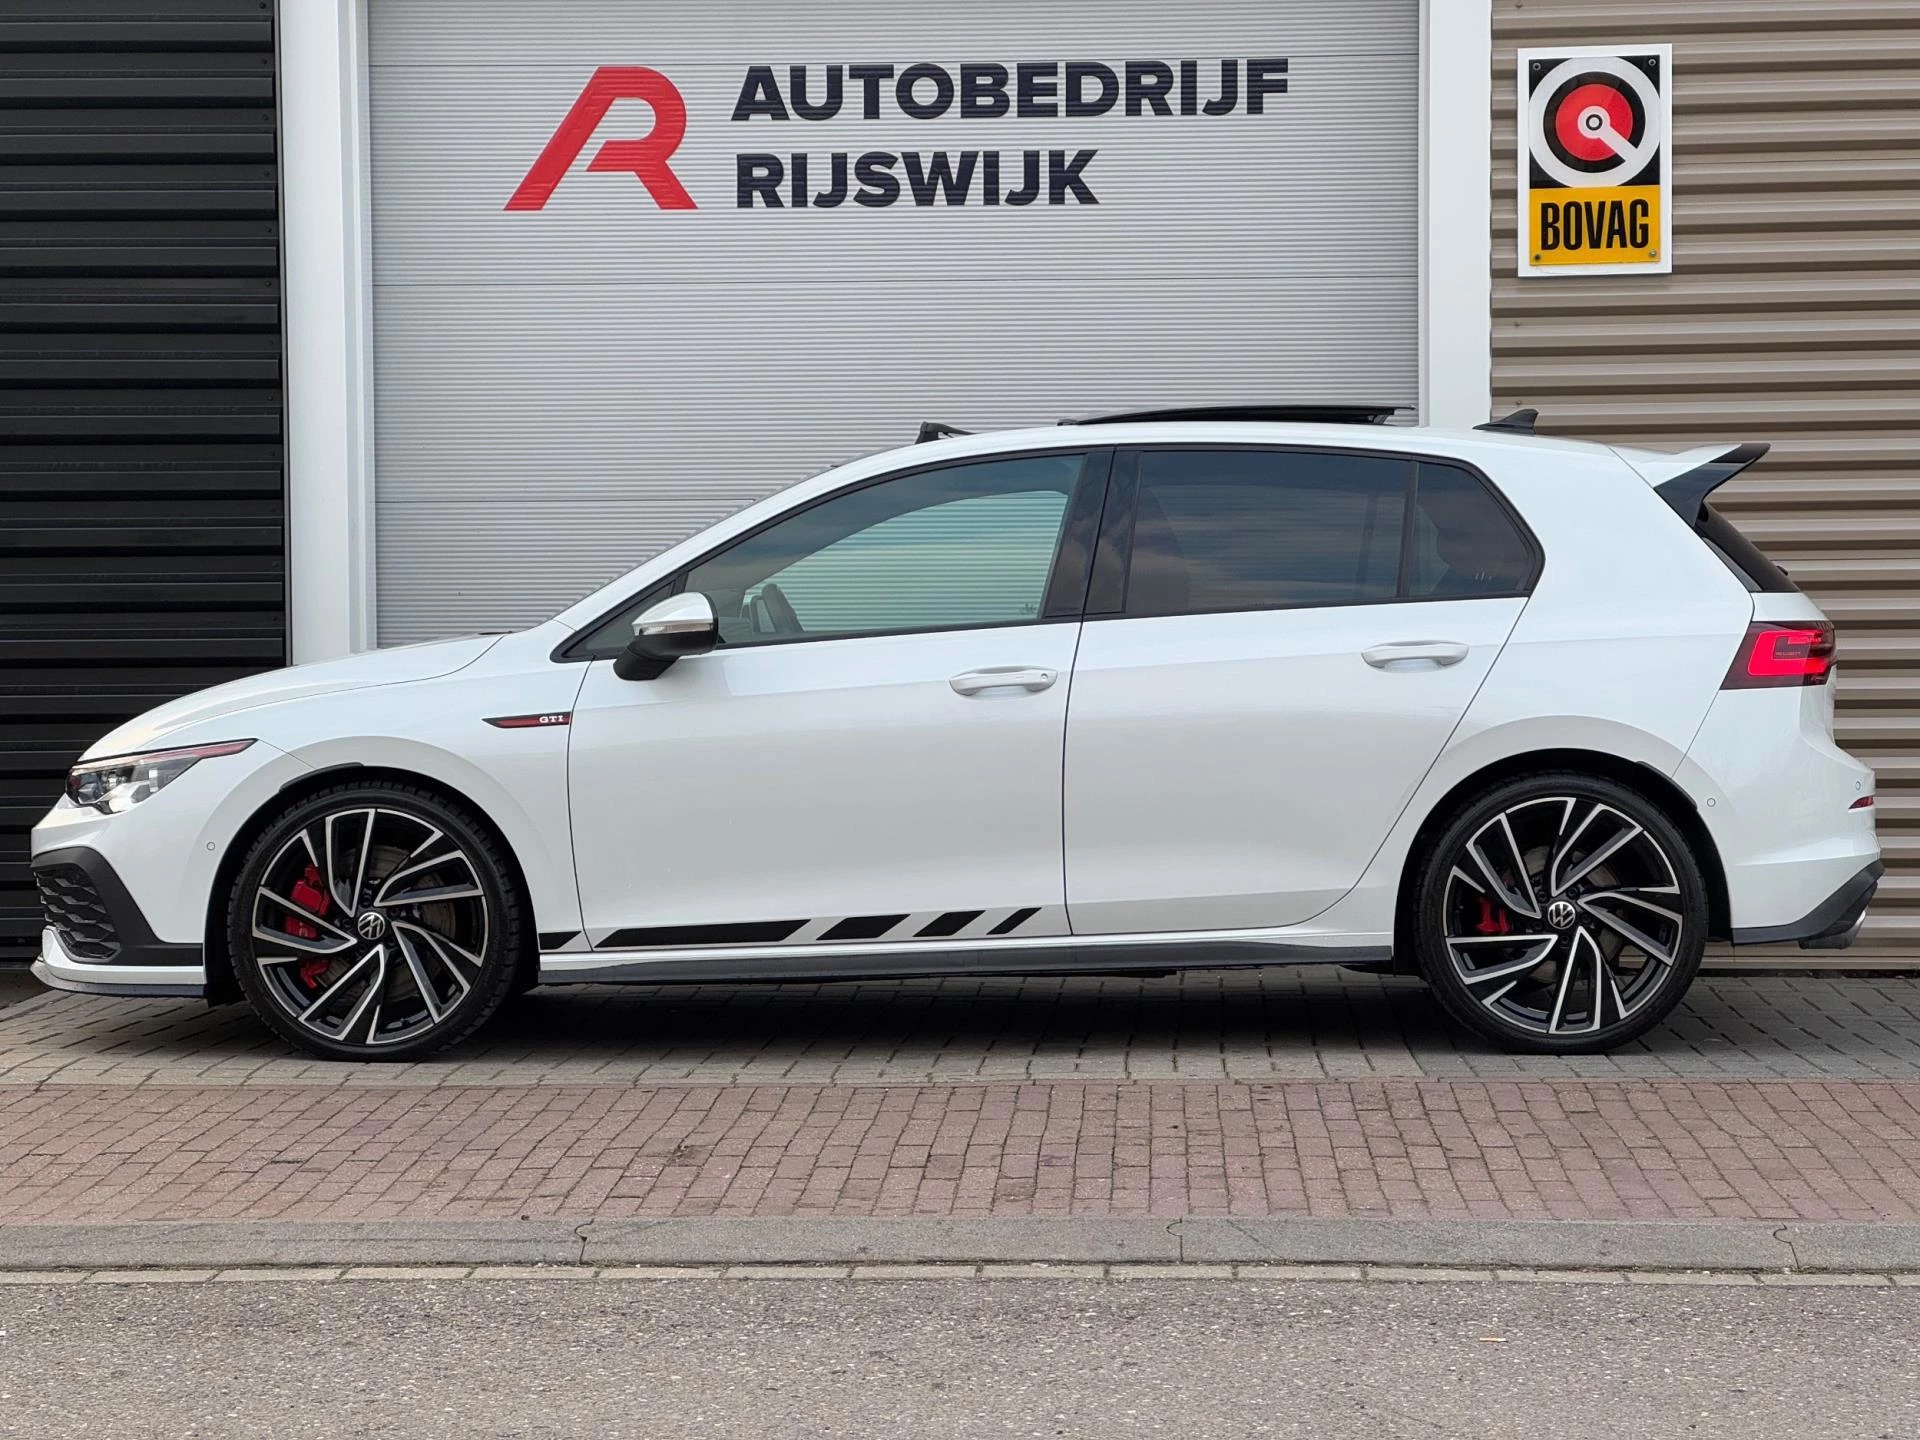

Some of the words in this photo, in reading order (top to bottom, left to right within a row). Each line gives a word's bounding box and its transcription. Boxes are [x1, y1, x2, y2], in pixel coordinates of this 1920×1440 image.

[731, 58, 1289, 122] AUTOBEDRIJF
[736, 150, 1100, 209] RIJSWIJK
[1540, 198, 1649, 251] BOVAG
[539, 715, 564, 724] GTI
